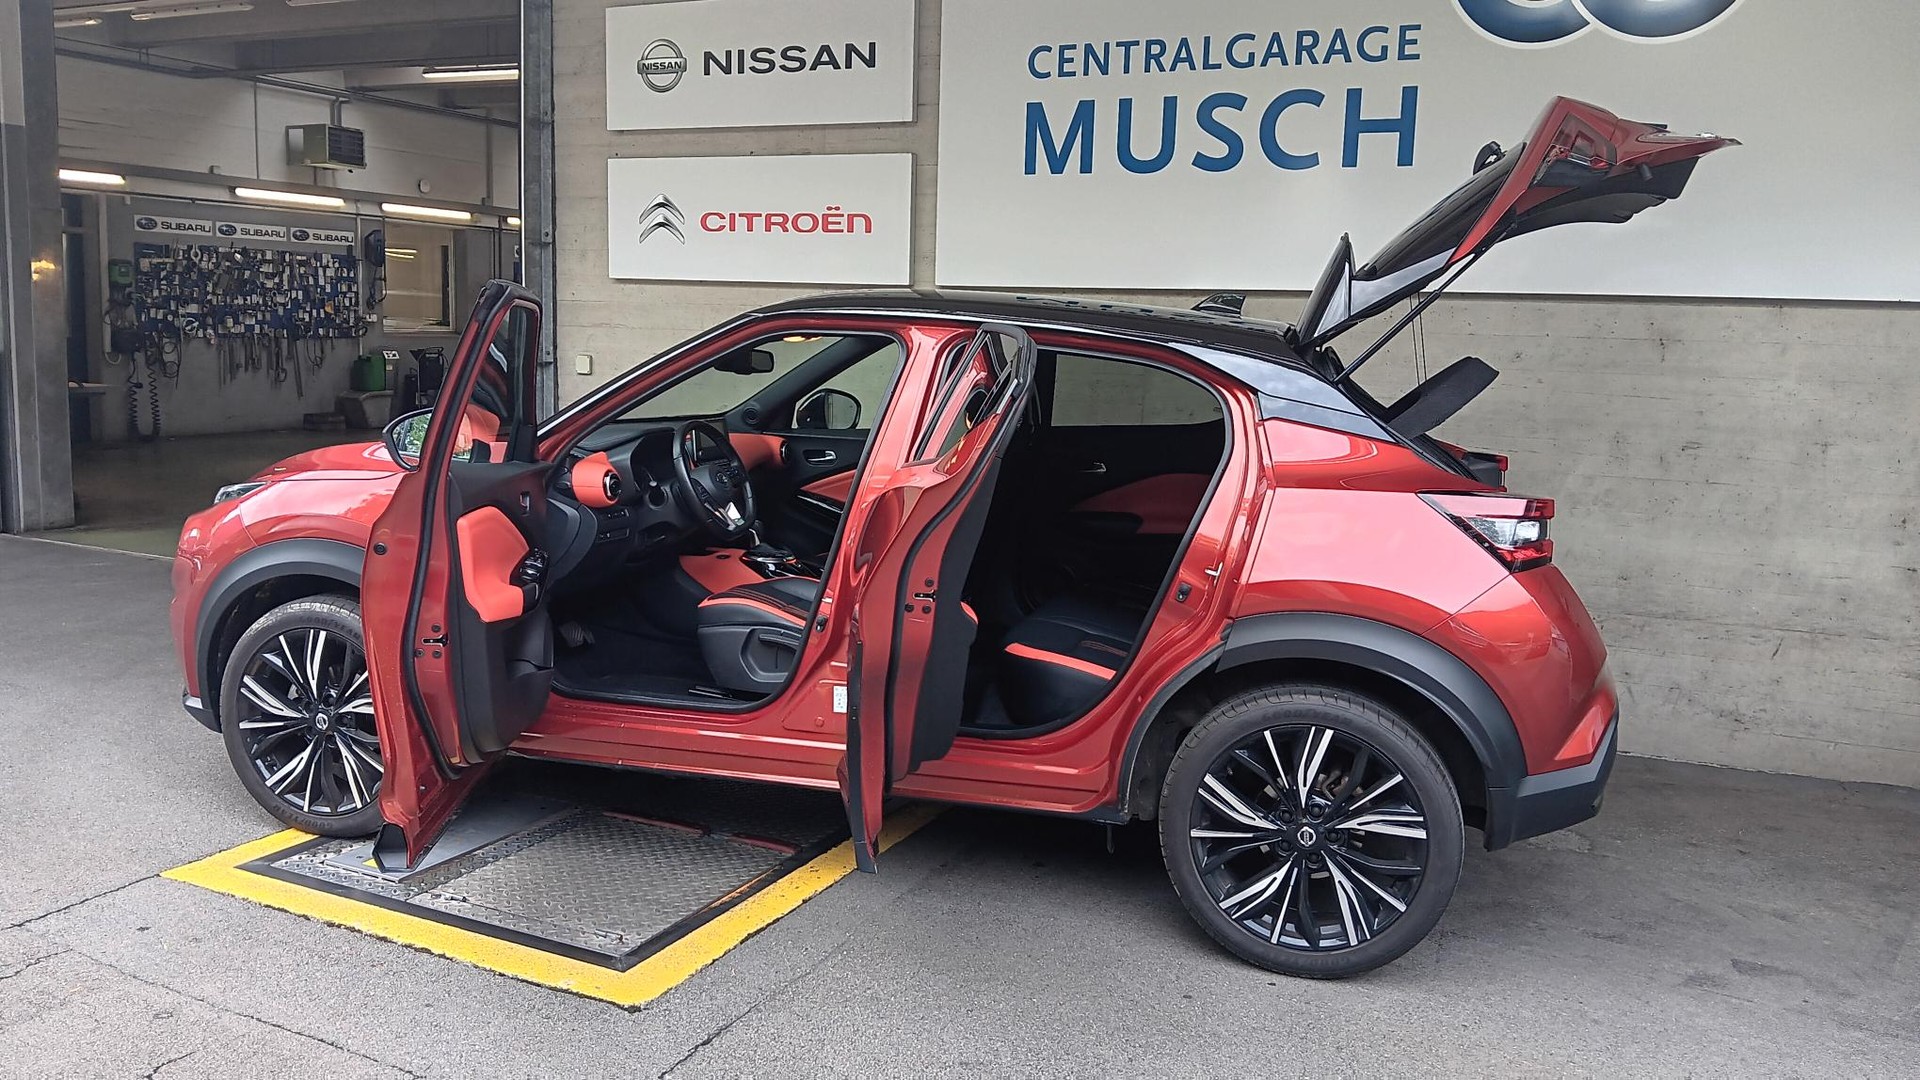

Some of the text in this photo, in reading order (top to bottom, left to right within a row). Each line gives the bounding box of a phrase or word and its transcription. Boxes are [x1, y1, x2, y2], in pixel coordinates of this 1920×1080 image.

[703, 42, 876, 76] NISSAN
[1027, 24, 1422, 79] CENTRALGARAGE
[642, 61, 682, 71] NISSAN
[1024, 86, 1418, 175] MUSCH
[161, 221, 211, 233] SUBARU
[700, 206, 872, 234] CITROËN
[240, 228, 286, 239] SUBARU
[312, 233, 354, 244] SUBARU
